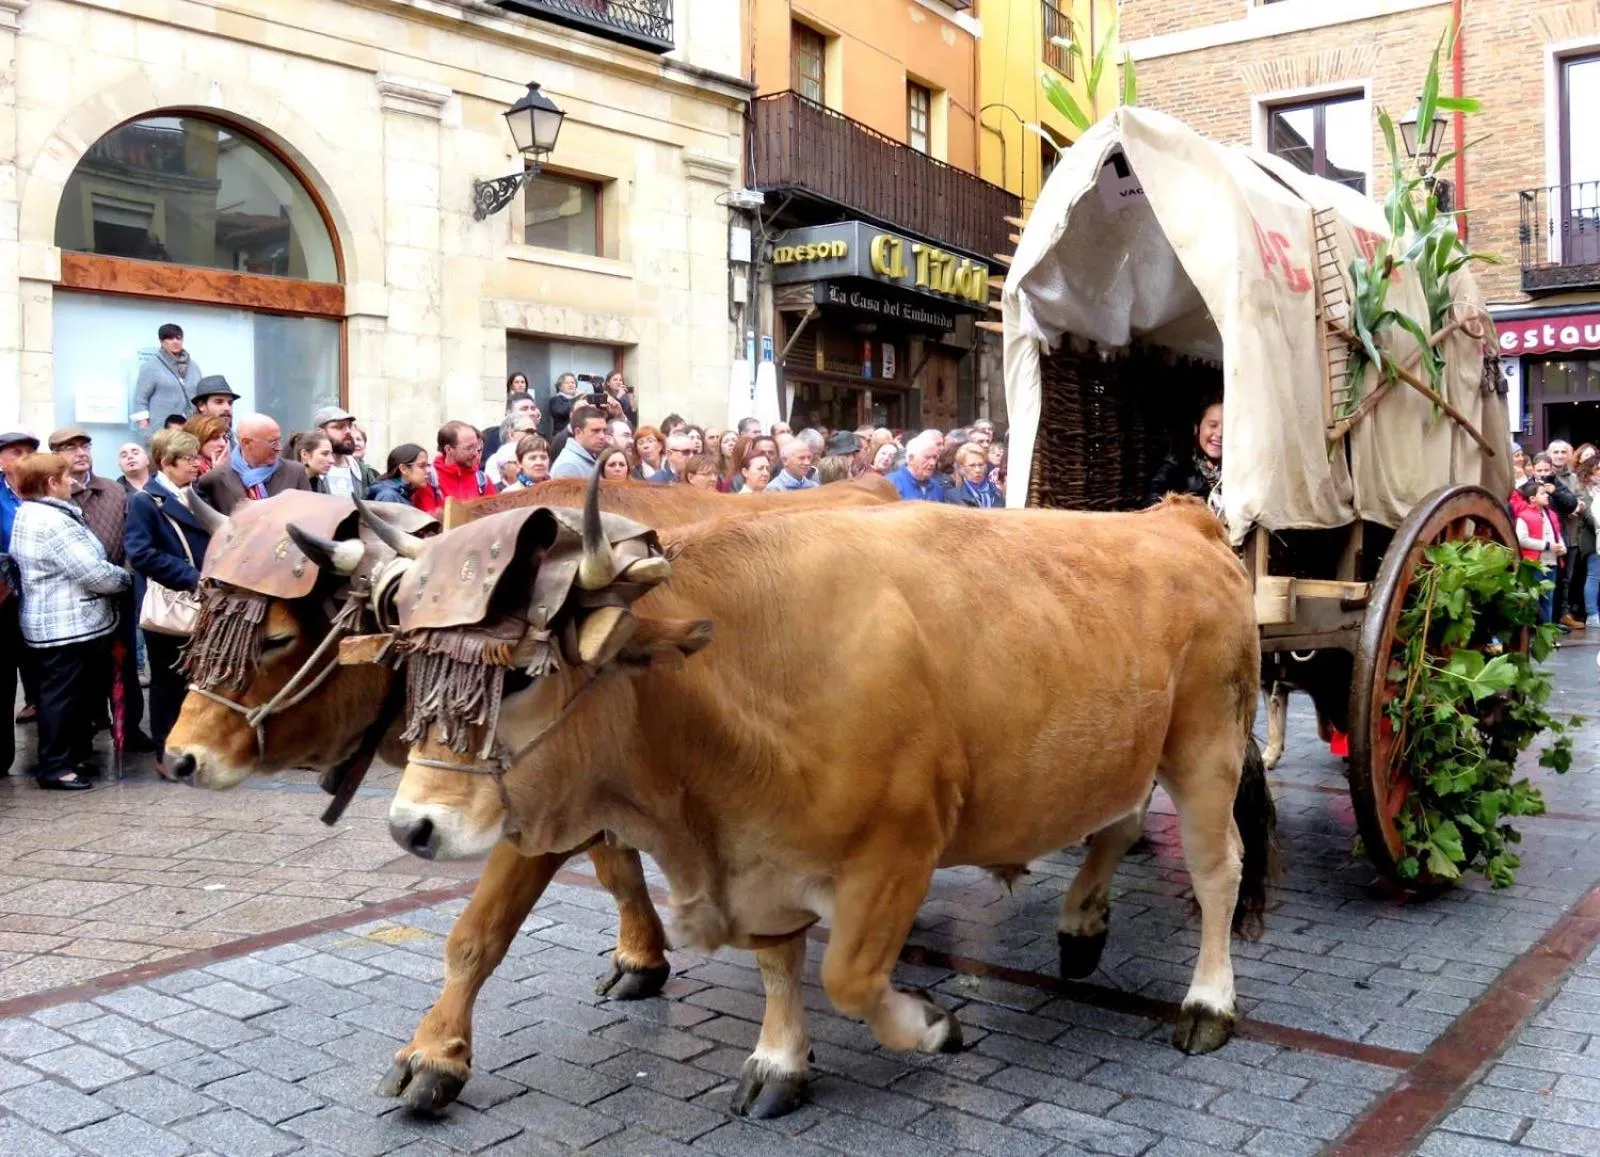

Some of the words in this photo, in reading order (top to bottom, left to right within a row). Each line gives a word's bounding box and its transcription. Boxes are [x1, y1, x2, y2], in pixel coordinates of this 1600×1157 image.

[829, 285, 847, 304] La
[850, 292, 880, 312] Casa
[883, 299, 900, 316] del
